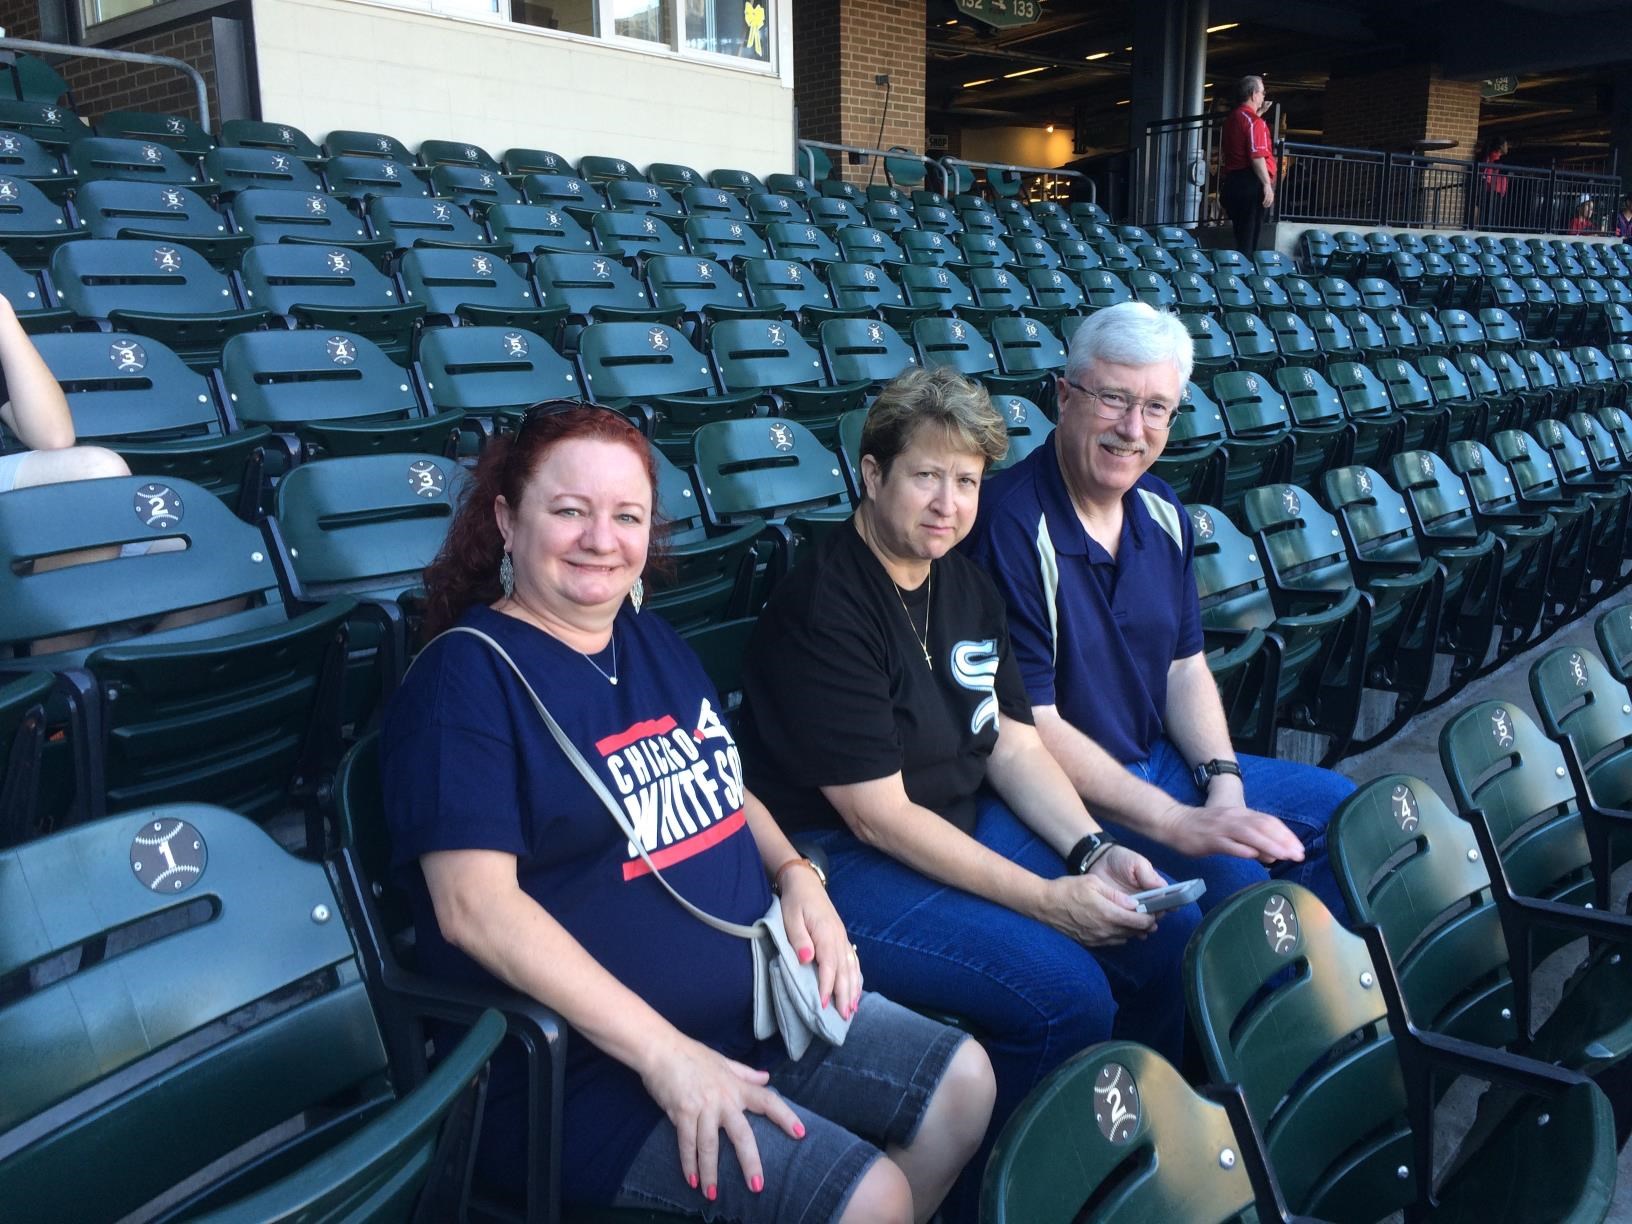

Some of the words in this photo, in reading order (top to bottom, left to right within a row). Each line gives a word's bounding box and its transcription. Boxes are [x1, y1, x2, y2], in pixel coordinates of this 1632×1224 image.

[1014, 1, 1034, 17] 133
[48, 111, 56, 120] 6
[172, 120, 179, 130] 7
[5, 139, 14, 149] 5
[380, 141, 387, 149] 9
[148, 149, 156, 159] 6
[466, 150, 476, 158] 10
[277, 158, 284, 168] 7
[386, 166, 393, 175] 8
[483, 176, 490, 185] 9
[1, 185, 11, 196] 4
[569, 182, 579, 190] 10
[649, 189, 657, 197] 11
[169, 193, 178, 204] 5
[718, 194, 727, 203] 12
[312, 200, 321, 209] 6
[437, 207, 444, 218] 7
[549, 215, 557, 223] 8
[646, 221, 653, 230] 9
[731, 226, 741, 235] 10
[807, 231, 815, 240] 11
[872, 234, 881, 242] 12
[162, 254, 173, 266] 4
[333, 257, 344, 268] 5
[478, 261, 487, 271] 6
[597, 263, 605, 274] 7
[701, 265, 708, 275] 8
[791, 270, 798, 279] 9
[865, 272, 874, 280] 10
[939, 274, 947, 282] 11
[999, 275, 1007, 283] 12
[873, 330, 880, 338] 8
[956, 327, 962, 336] 9
[1026, 326, 1036, 335] 10
[654, 334, 663, 344] 6
[772, 330, 780, 342] 7
[511, 339, 521, 351] 5
[336, 344, 348, 357] 4
[120, 349, 135, 363] 3
[1247, 381, 1257, 389] 10
[1304, 376, 1312, 384] 11
[1013, 406, 1021, 418] 7
[776, 430, 787, 443] 5
[1472, 450, 1480, 458] 10
[1423, 461, 1430, 470] 9
[418, 472, 433, 487] 3
[1361, 477, 1367, 487] 8
[149, 497, 169, 516] 2
[1287, 496, 1294, 508] 7
[1574, 664, 1583, 678] 6
[1497, 721, 1507, 736] 5
[624, 760, 723, 858] WHITE
[1402, 800, 1411, 817] 4
[159, 840, 177, 868] 1
[1272, 913, 1287, 937] 3
[1106, 1088, 1127, 1122] 2
